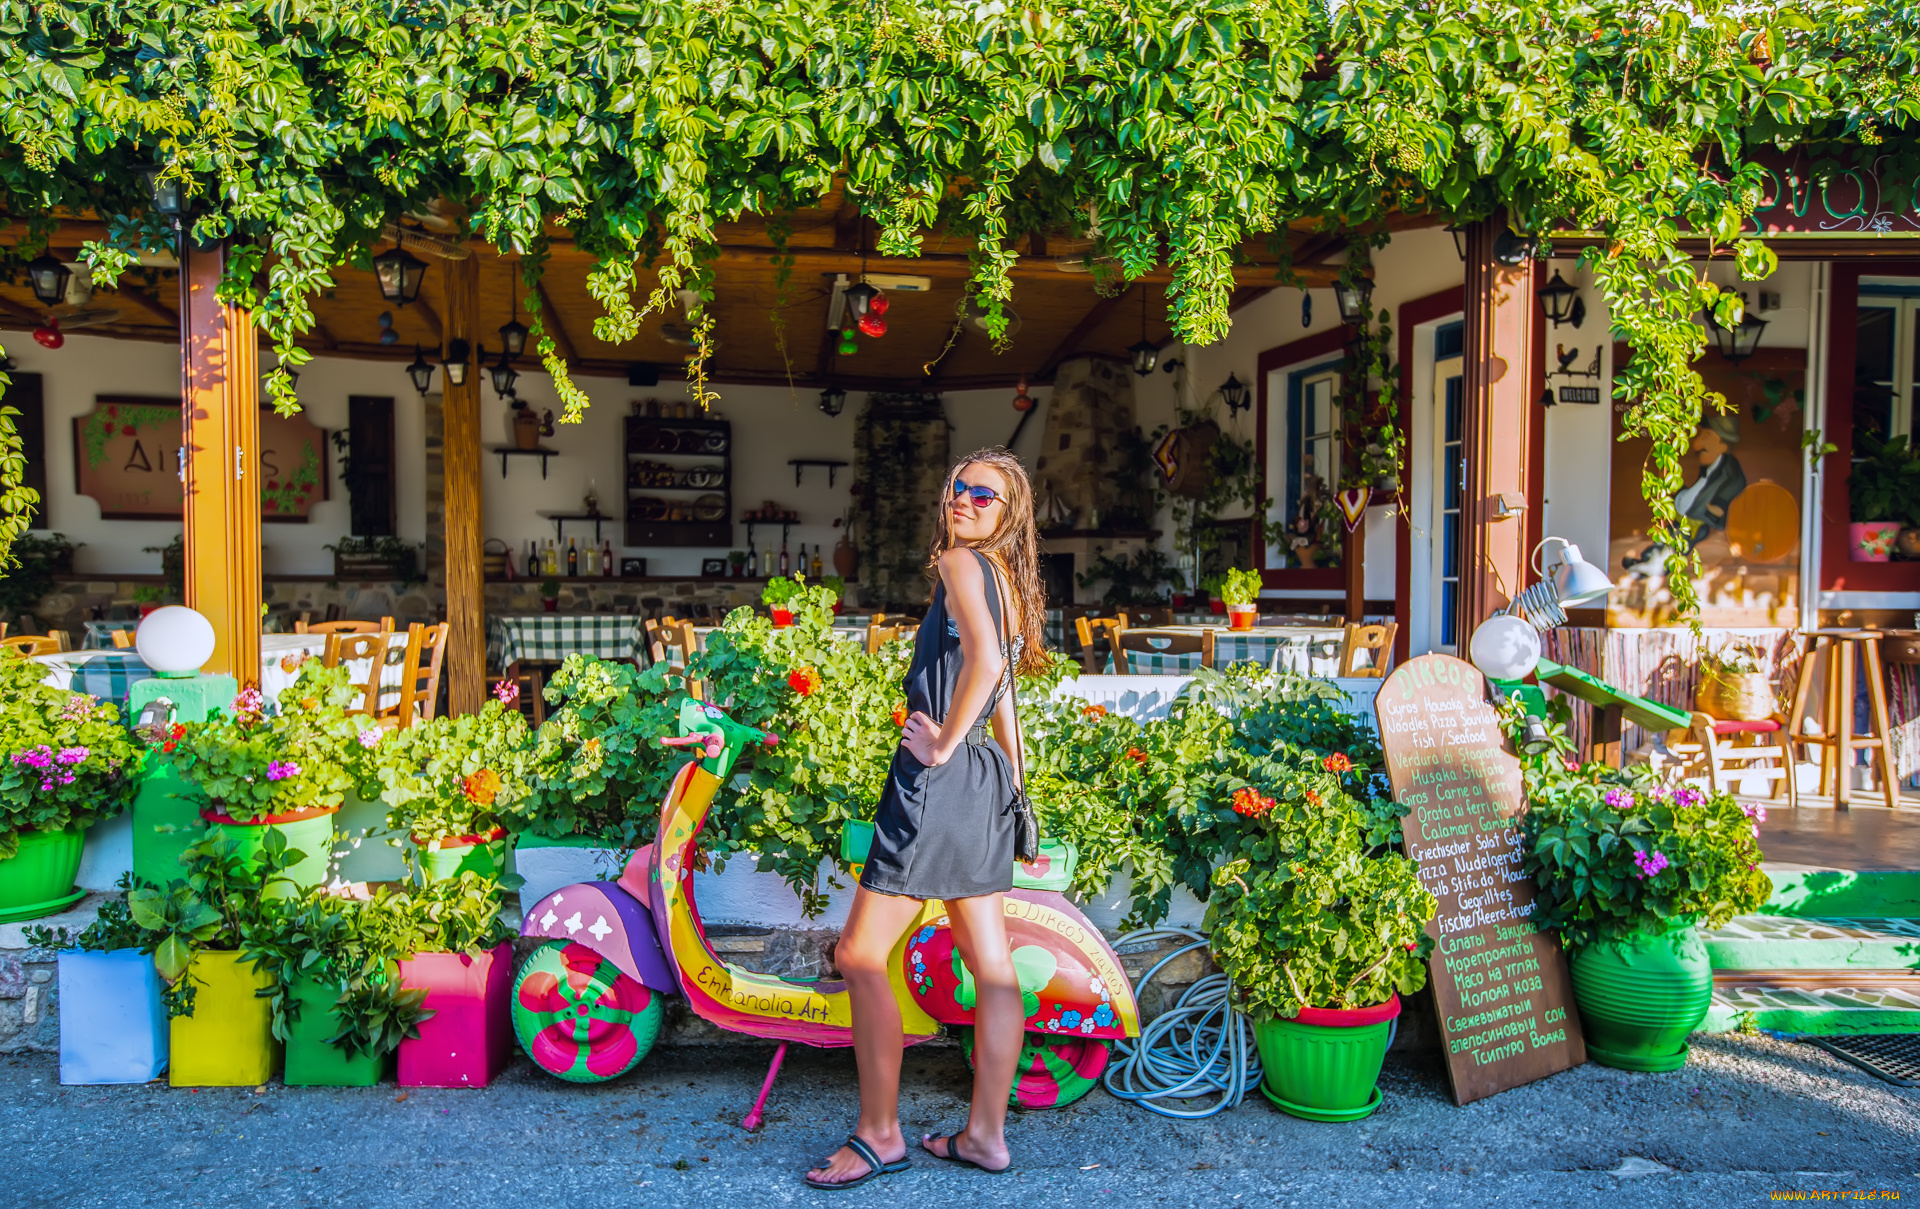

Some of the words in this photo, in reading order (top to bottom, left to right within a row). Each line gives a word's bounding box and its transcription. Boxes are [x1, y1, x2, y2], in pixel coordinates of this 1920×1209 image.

[1386, 697, 1418, 717] Gyros
[1385, 715, 1428, 734] Noodles
[1431, 714, 1457, 730] Pizza
[1447, 729, 1487, 746] Seafood
[1394, 751, 1440, 769] Verdura
[1443, 749, 1454, 764] di
[1458, 746, 1503, 765] Stagione
[1411, 768, 1458, 787] Musaka
[1463, 761, 1505, 780] Stufato
[1399, 788, 1429, 808] Giros
[1435, 783, 1470, 802] Carne
[1472, 782, 1483, 797] ai
[1486, 779, 1511, 796] ferri
[1417, 804, 1452, 824] Orata
[1454, 803, 1464, 818] ai
[1466, 800, 1491, 818] ferri
[1421, 822, 1474, 842] Calamari
[1410, 842, 1471, 862] Griechischer
[1458, 888, 1513, 912] Gegrilltes
[1439, 933, 1486, 955] Салаты
[1445, 941, 1534, 974] Морепродукты
[1488, 966, 1502, 982] на
[1513, 975, 1543, 995] коза
[1544, 1006, 1567, 1025] сок
[1530, 1028, 1566, 1049] Водка
